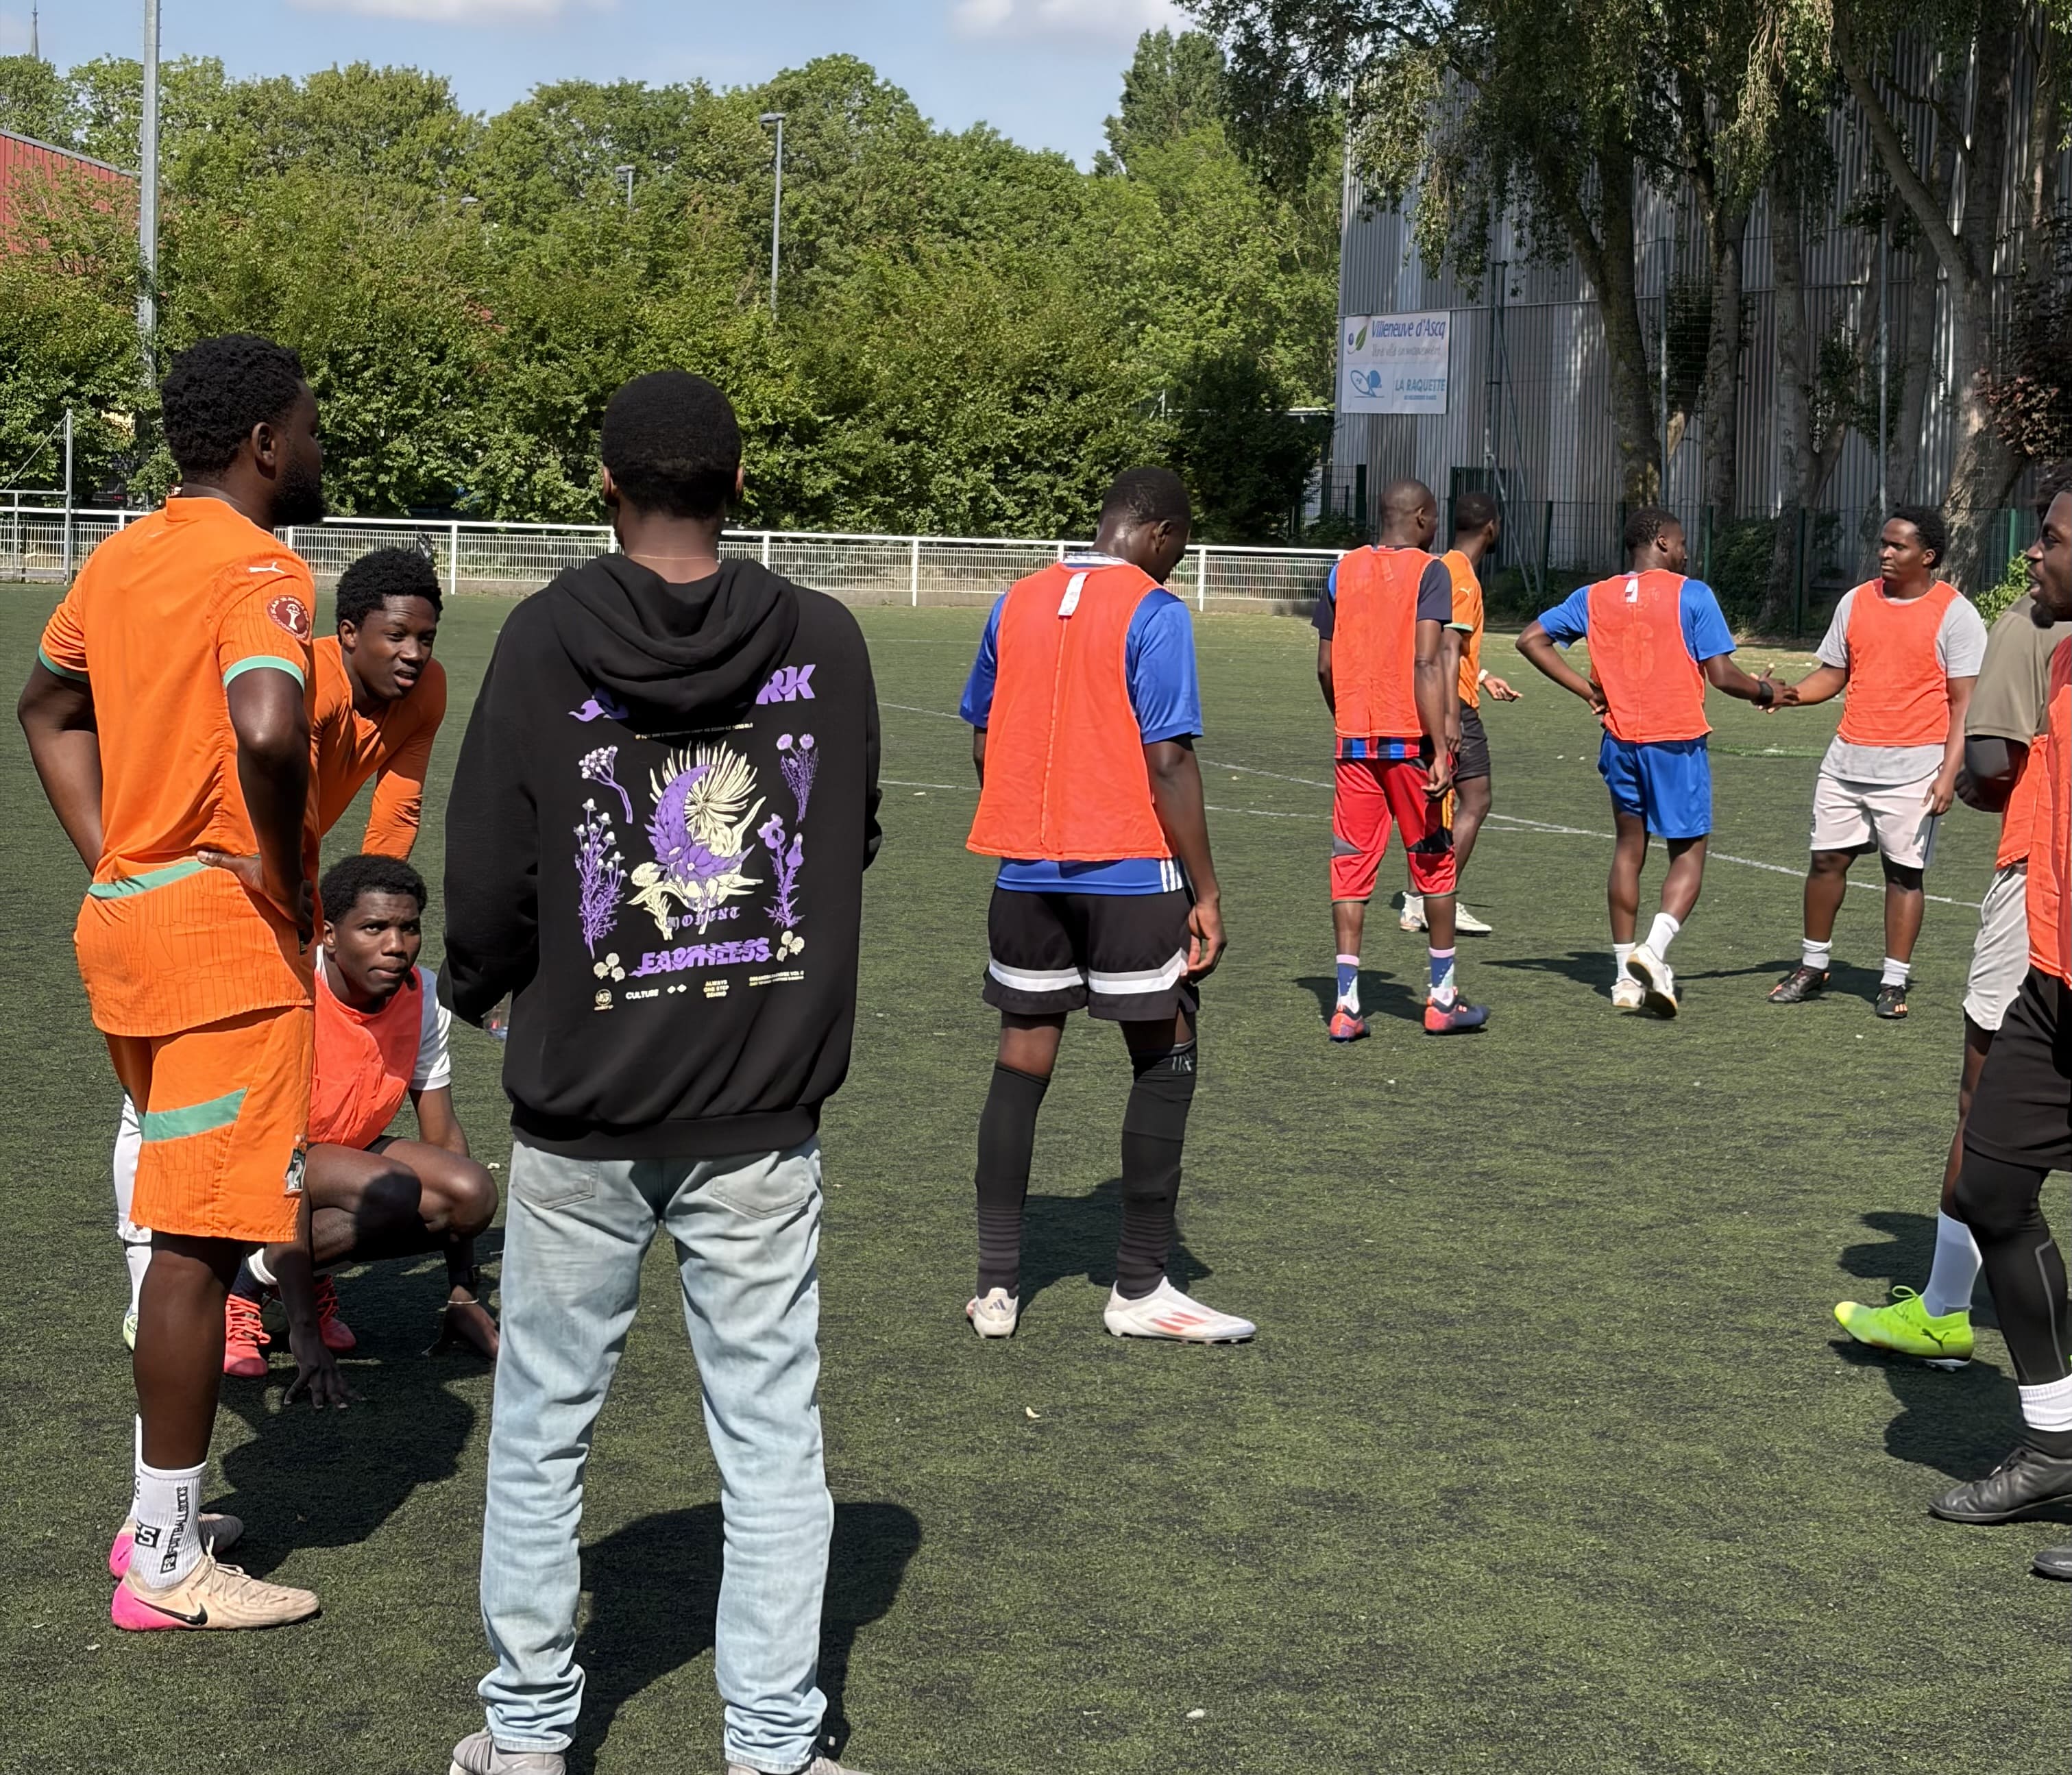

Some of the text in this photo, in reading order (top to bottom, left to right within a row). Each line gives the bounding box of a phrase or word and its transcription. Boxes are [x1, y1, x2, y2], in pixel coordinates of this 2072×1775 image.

[1372, 318, 1446, 339] Villeneuve d'Ascq
[1395, 378, 1446, 393] LA RAQUETTE
[625, 988, 659, 1000] CULTURE
